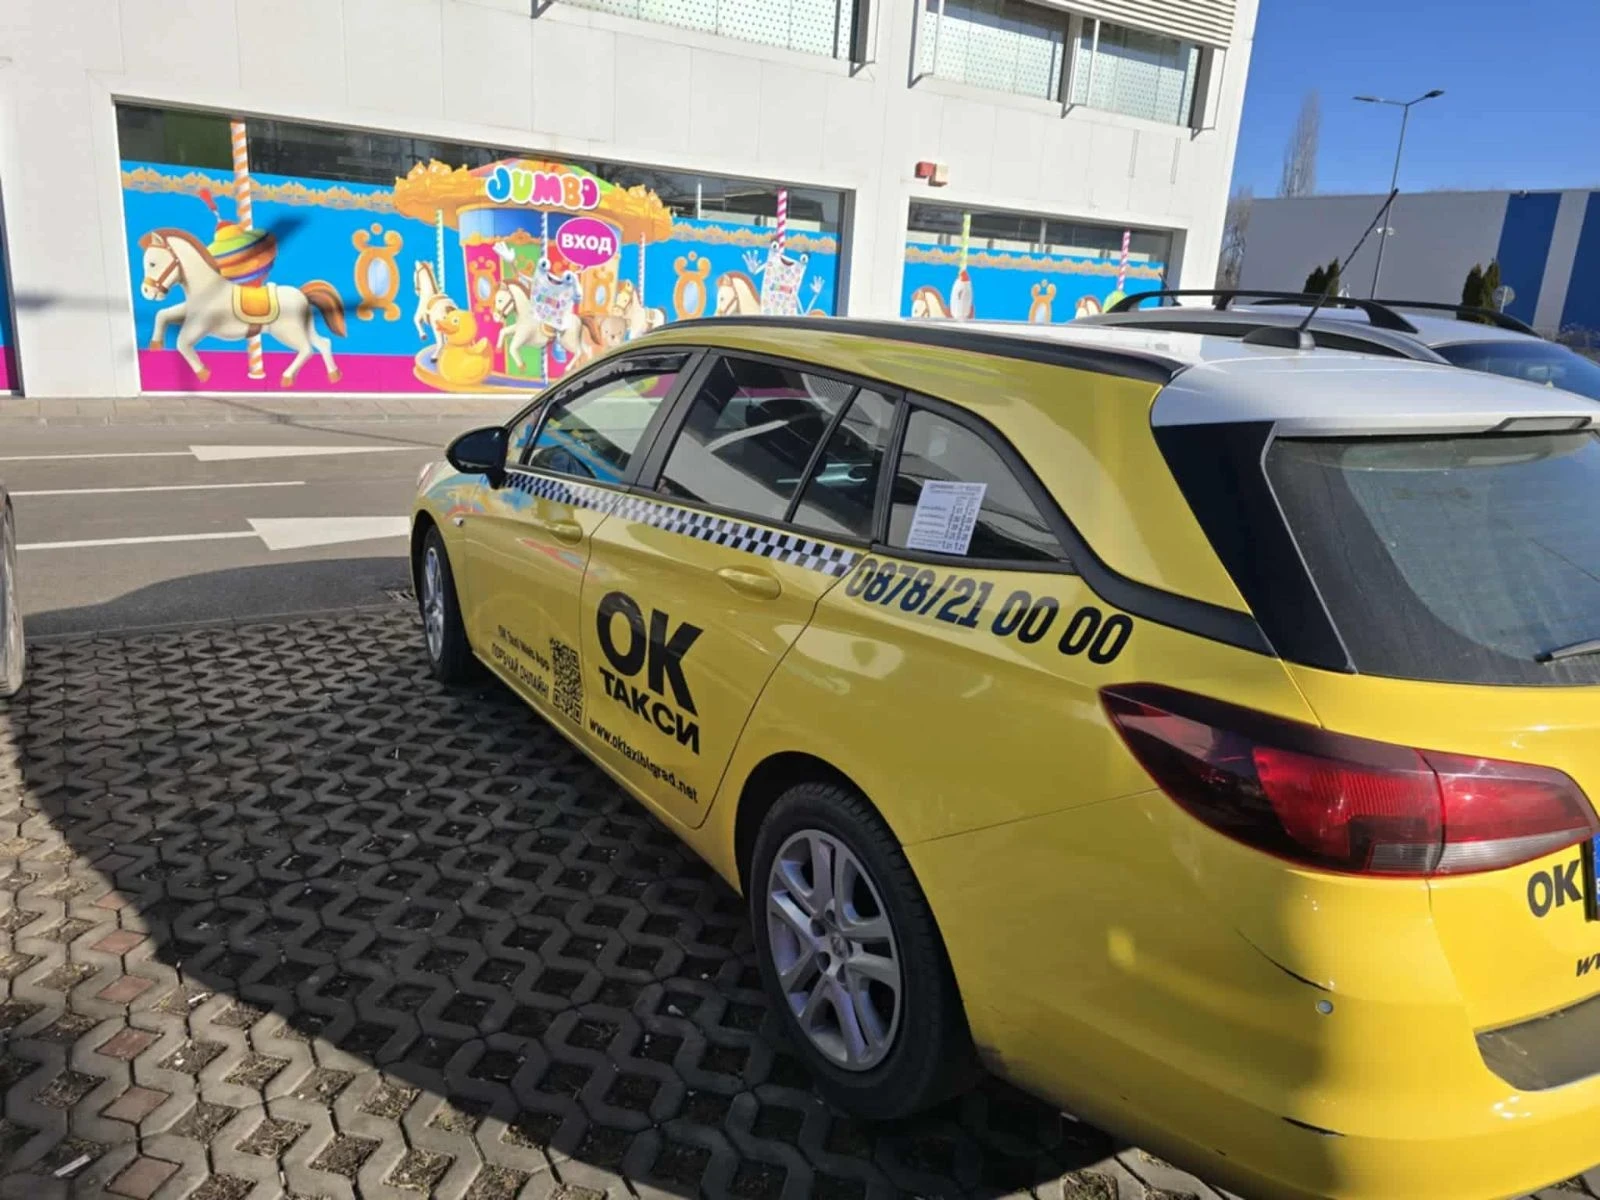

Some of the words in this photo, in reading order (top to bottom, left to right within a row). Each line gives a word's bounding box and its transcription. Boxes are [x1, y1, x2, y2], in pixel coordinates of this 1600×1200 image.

[487, 166, 599, 209] JUMBO
[561, 233, 612, 255] ВХОД
[845, 557, 994, 629] 0878/21
[991, 590, 1060, 644] 00
[1058, 606, 1134, 664] 00
[598, 666, 700, 755] ТАКСИ
[1527, 859, 1583, 917] OK
